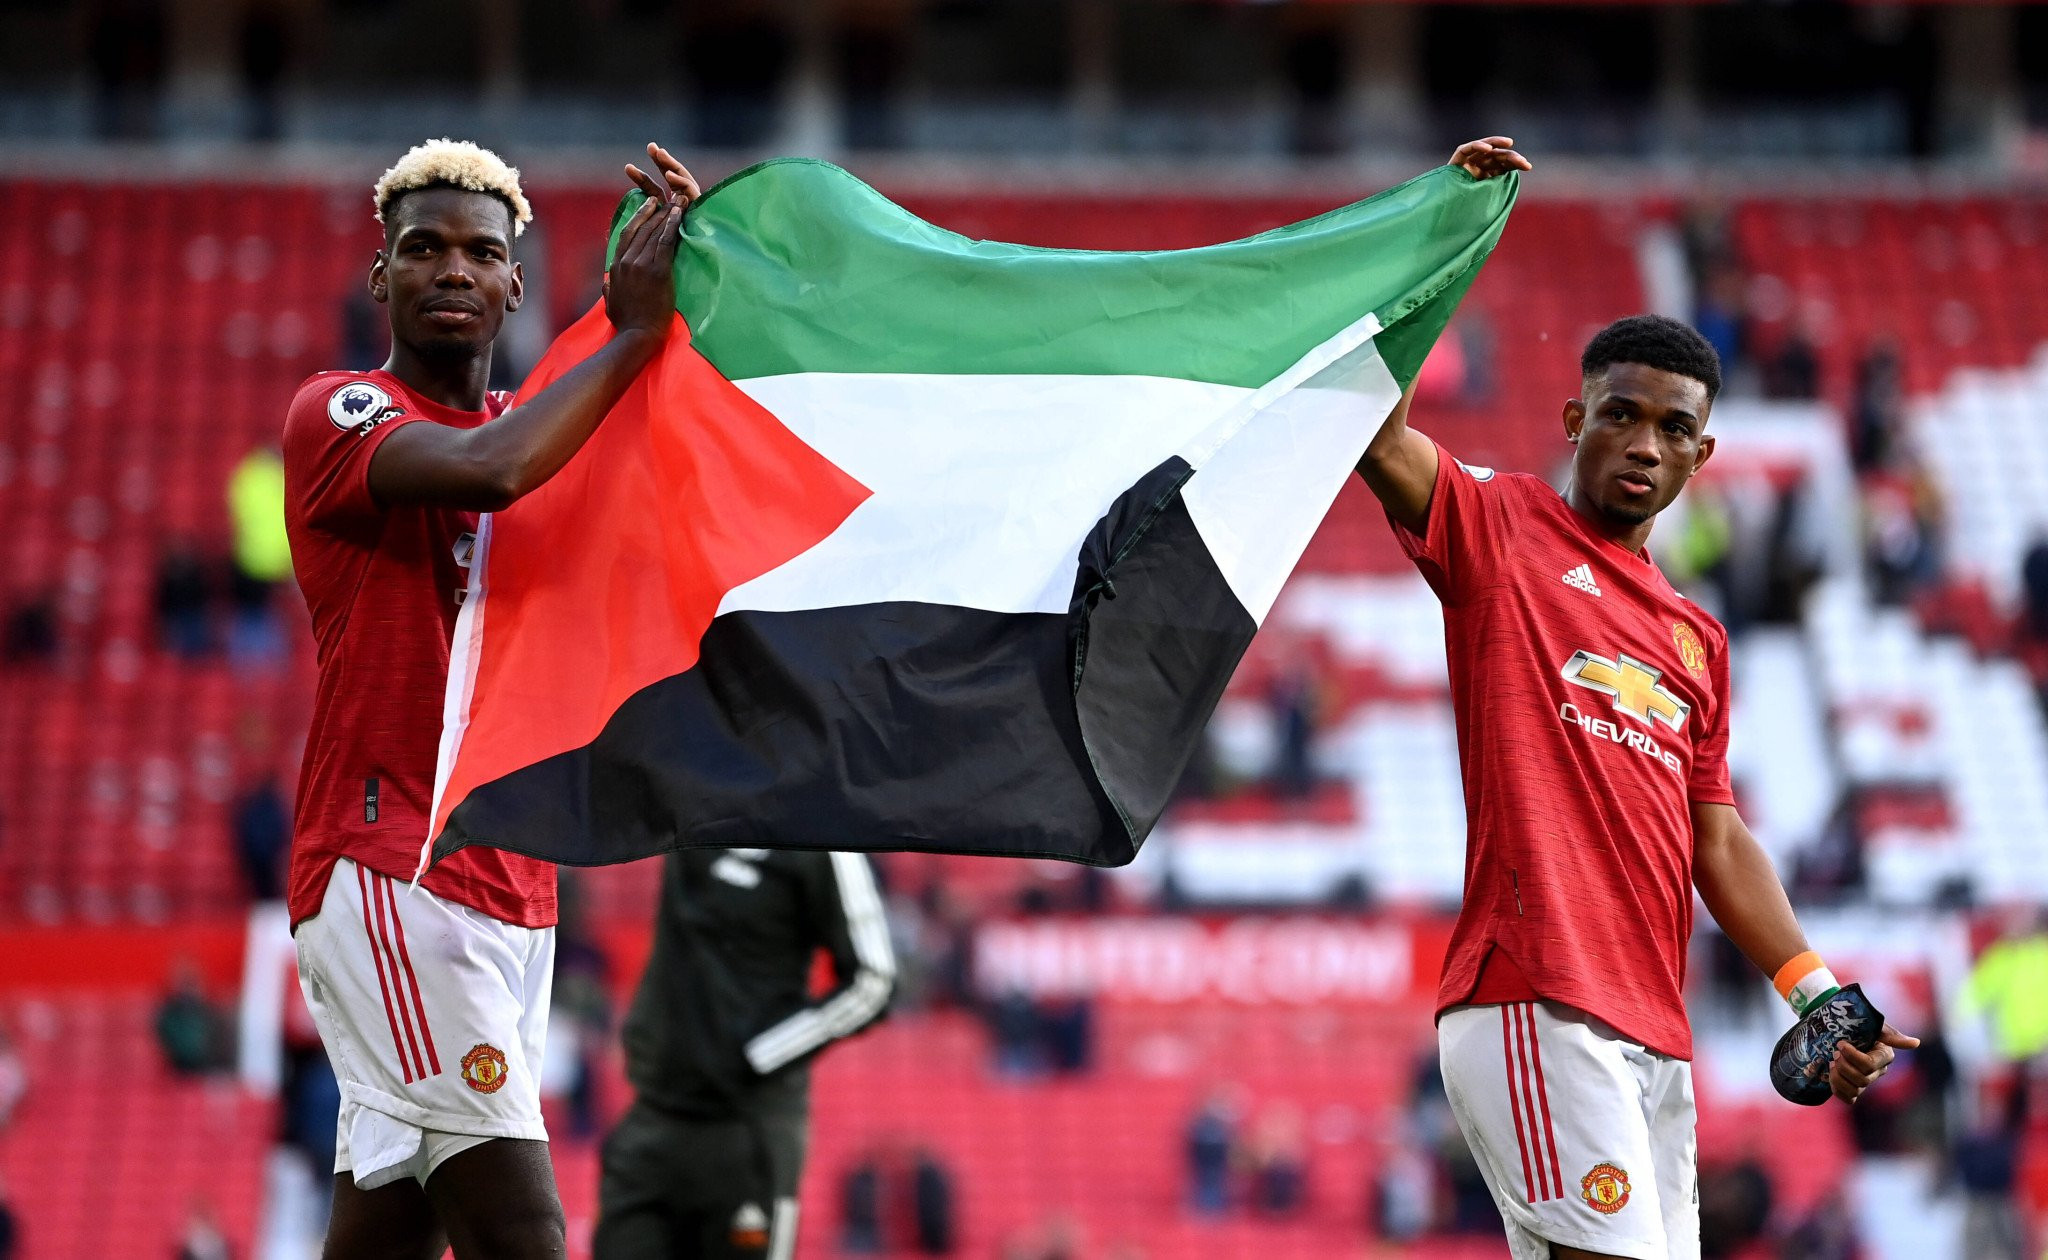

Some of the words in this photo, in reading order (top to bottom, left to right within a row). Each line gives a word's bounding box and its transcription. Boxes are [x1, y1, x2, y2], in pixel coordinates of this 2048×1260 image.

[1561, 574, 1602, 597] adidas
[465, 1047, 502, 1066] MANCHESTER
[475, 1081, 502, 1091] UNITED
[1585, 1167, 1625, 1187] MANCHESTER
[1596, 1199, 1624, 1211] UNITED
